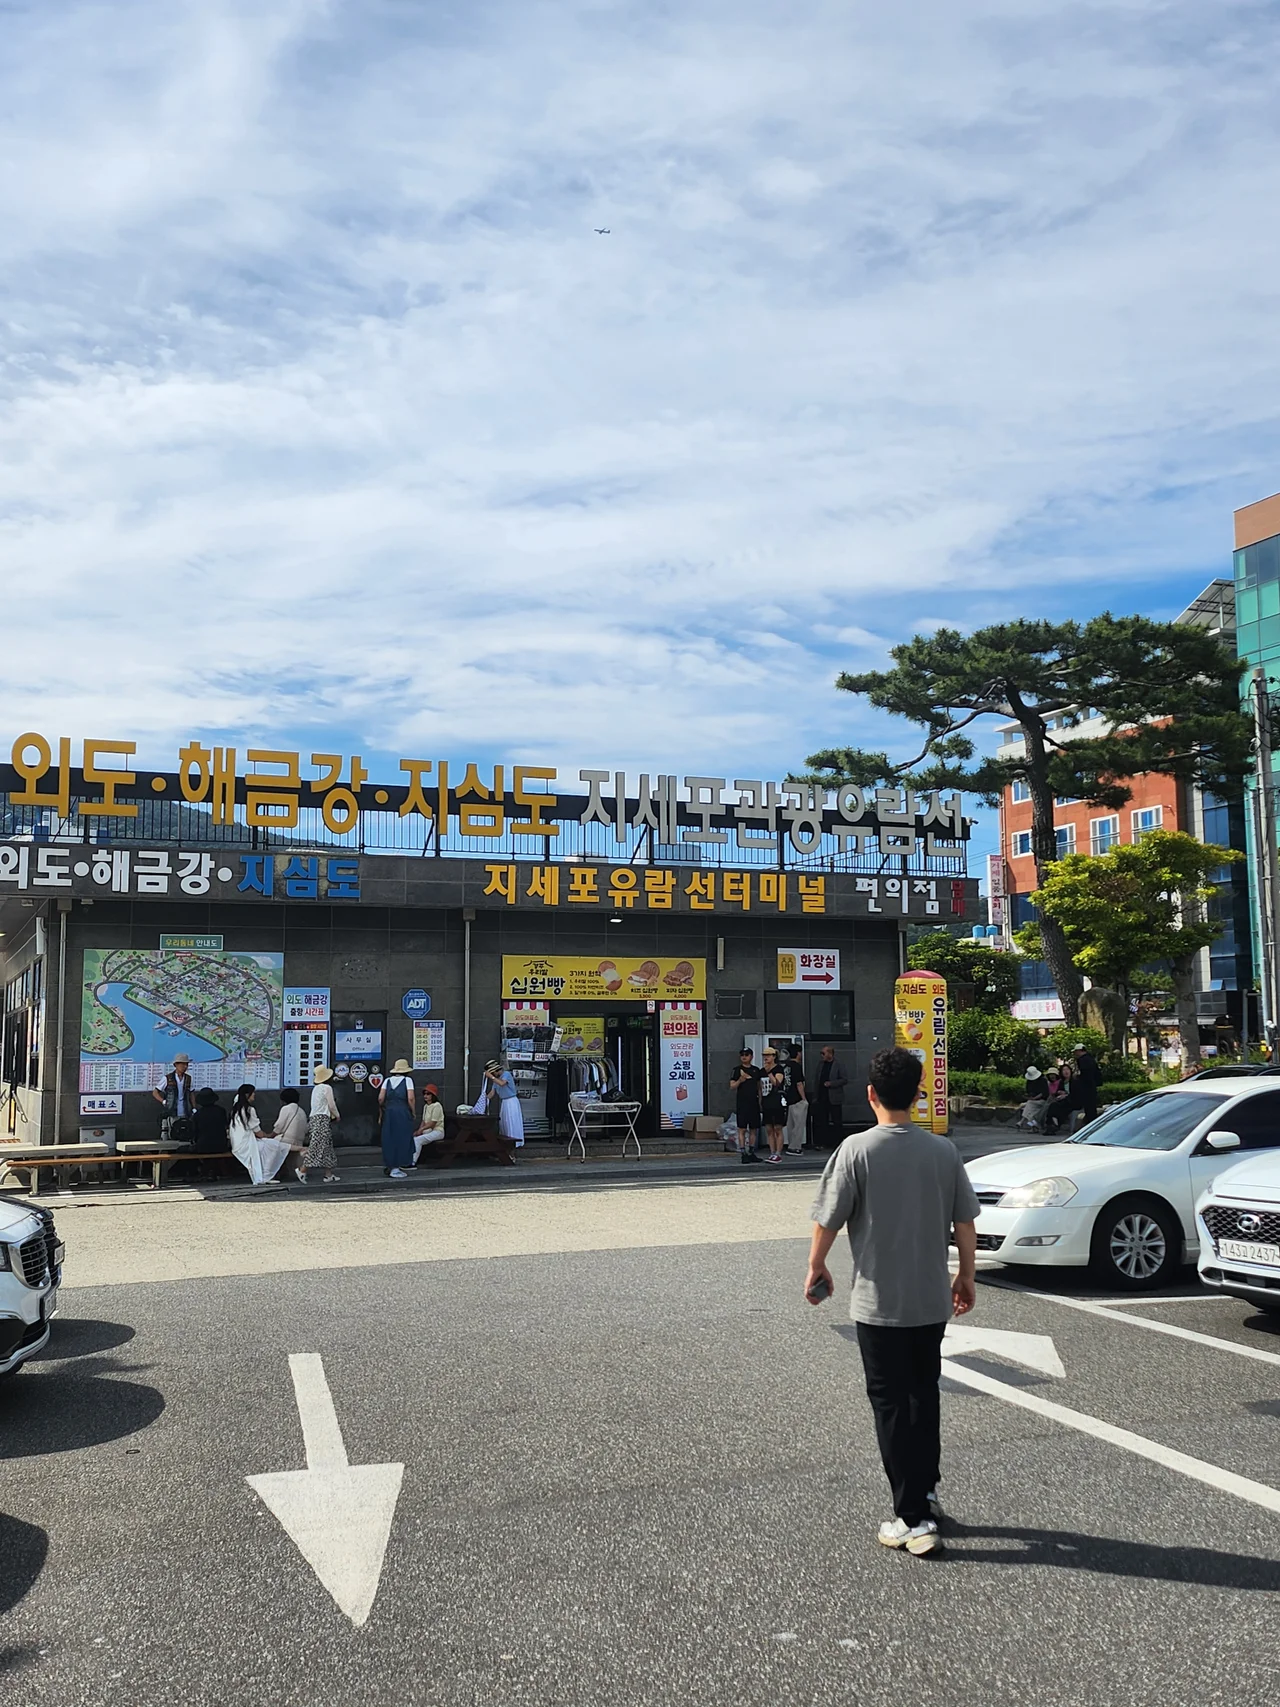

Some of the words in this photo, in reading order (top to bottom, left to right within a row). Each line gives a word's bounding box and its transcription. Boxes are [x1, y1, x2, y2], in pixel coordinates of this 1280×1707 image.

[579, 769, 966, 857] 지세포관광유람선
[855, 878, 940, 915] 편의점
[196, 939, 218, 947] 안내도
[800, 953, 836, 969] 화장실
[510, 977, 566, 995] 십원빵
[932, 984, 945, 995] 외도
[286, 994, 302, 1005] 외도
[304, 994, 328, 1005] 해금강
[407, 998, 427, 1009] ADT
[290, 1007, 303, 1016] 출항
[304, 1007, 325, 1016] 시간표
[663, 1021, 699, 1036] 편의점
[670, 1042, 694, 1050] 외도관광
[673, 1060, 691, 1070] 쇼핑
[669, 1070, 696, 1081] 오세요
